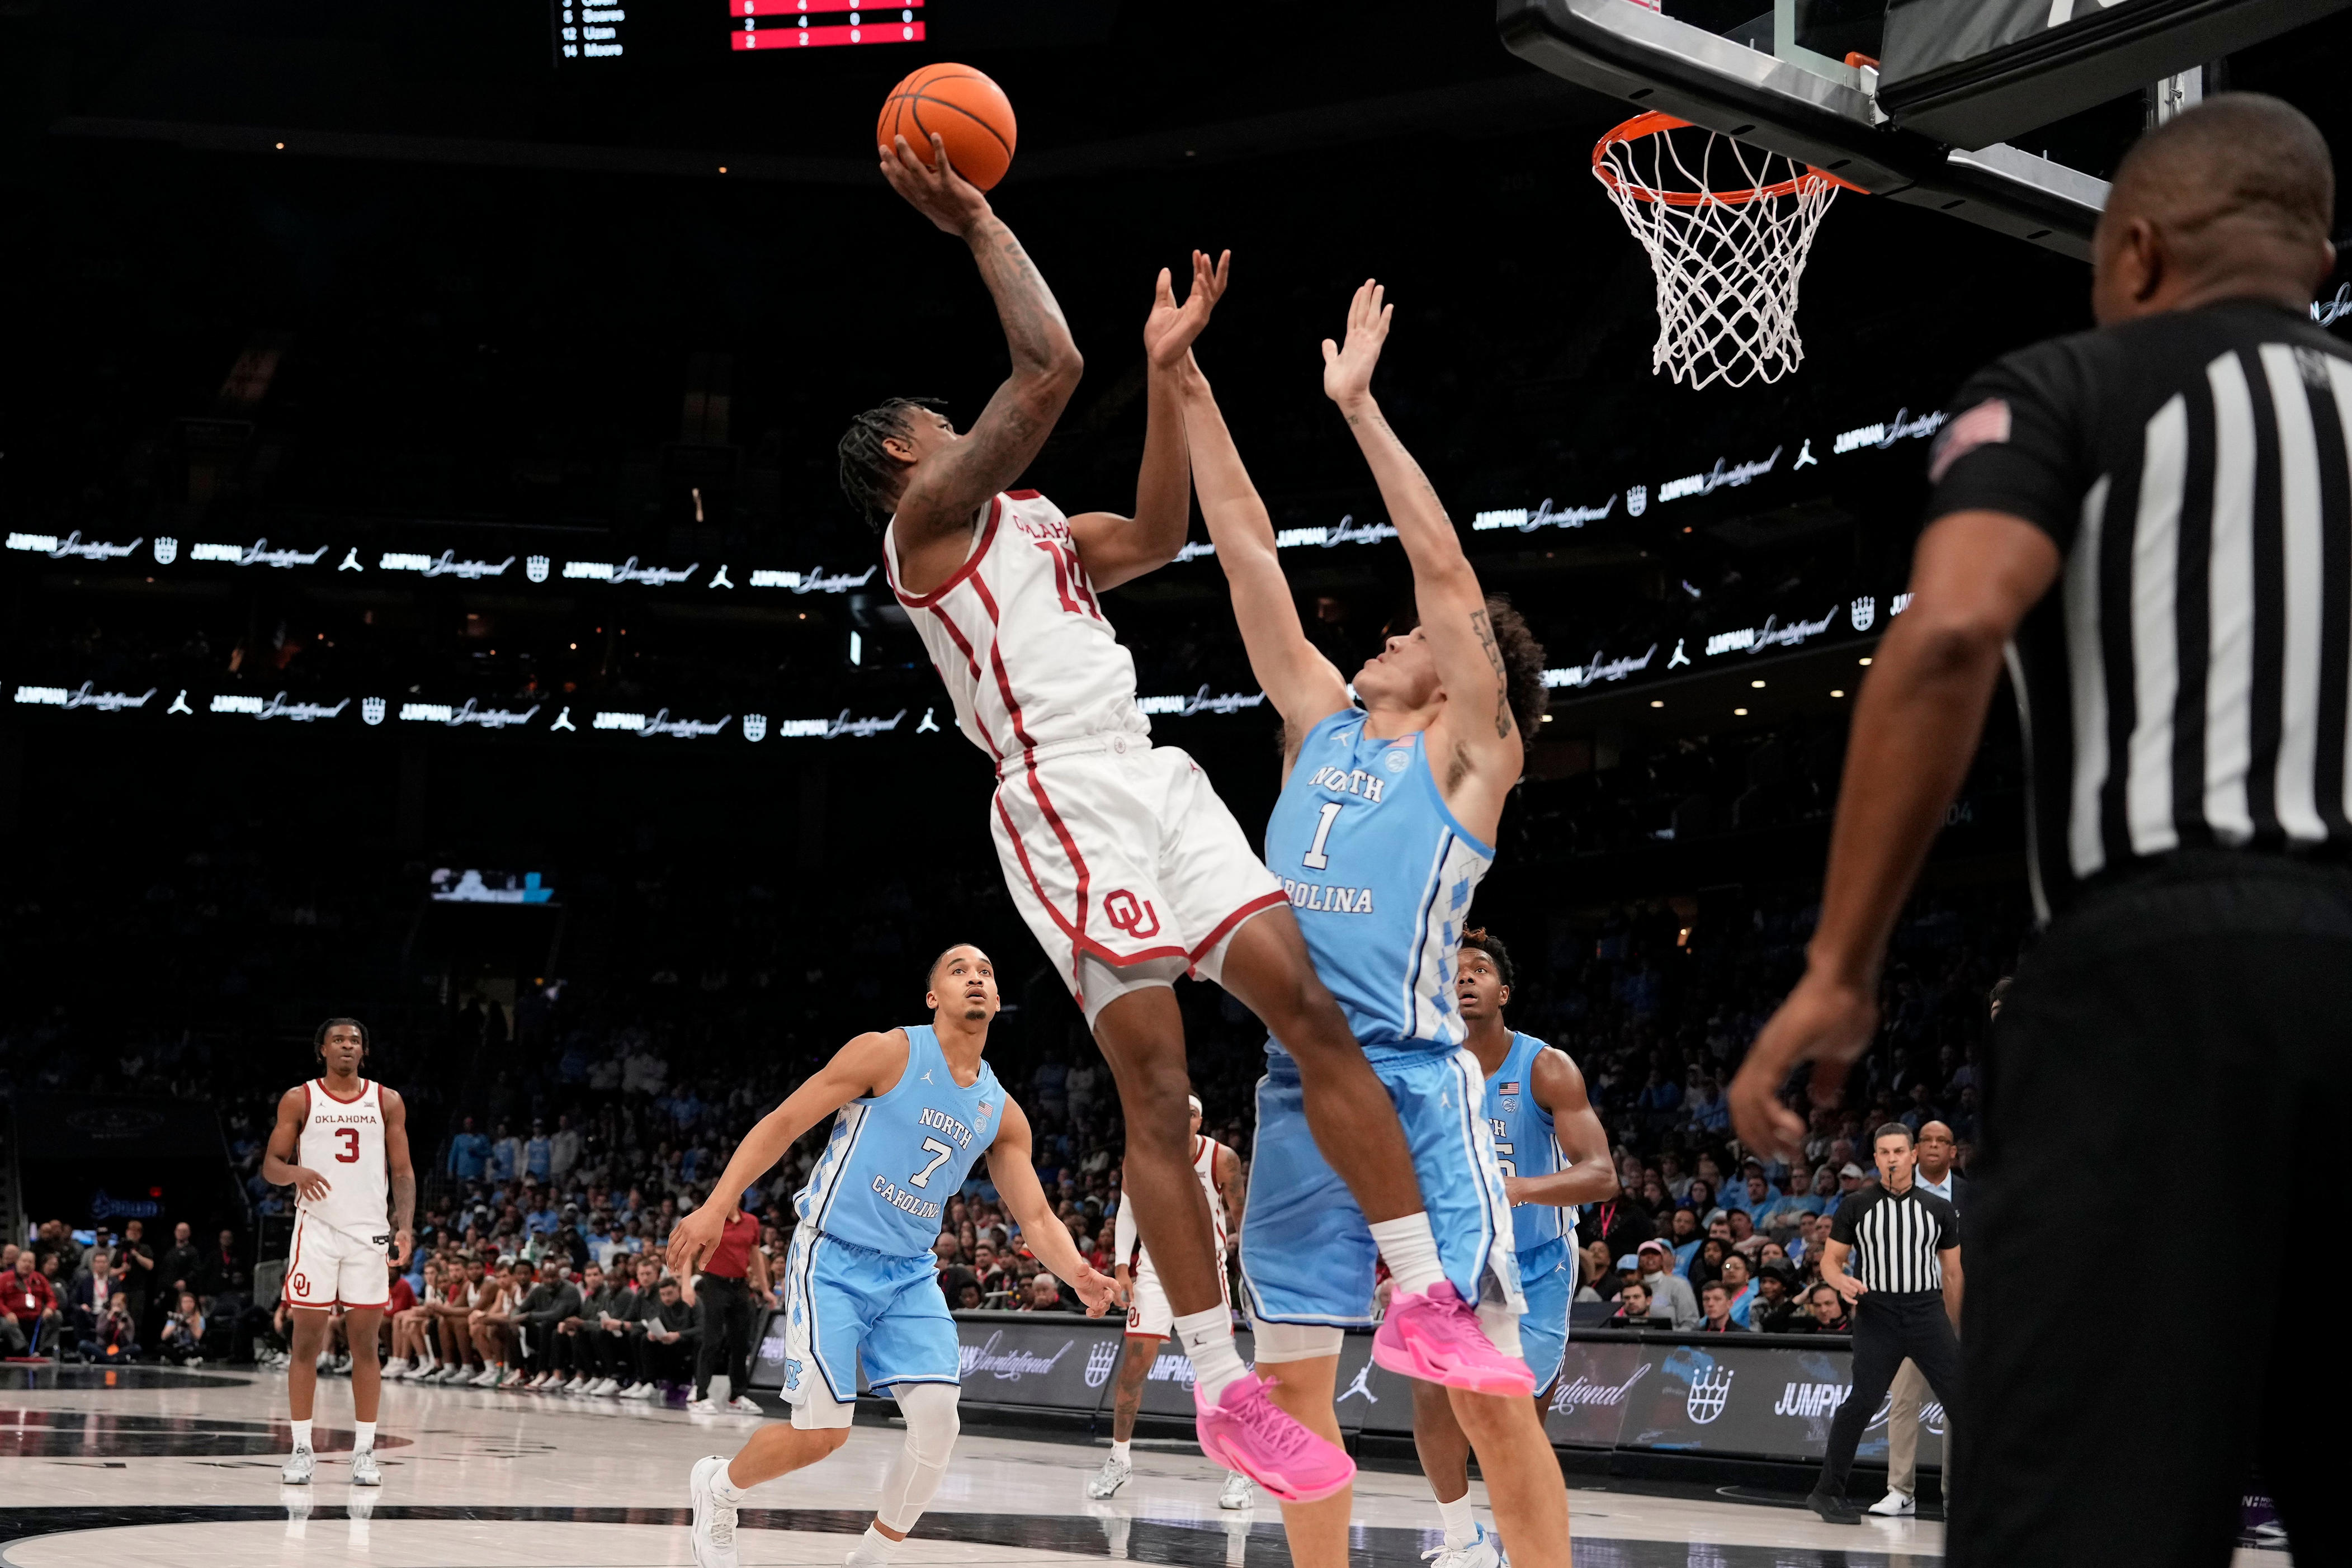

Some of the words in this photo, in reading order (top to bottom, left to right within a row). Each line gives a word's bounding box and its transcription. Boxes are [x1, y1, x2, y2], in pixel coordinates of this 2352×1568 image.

[849, 12, 860, 26] 0
[902, 9, 913, 23] 0
[851, 29, 861, 43] 0
[903, 26, 913, 40] 0
[1302, 801, 1343, 871] 1
[1103, 889, 1161, 939] OU
[315, 1115, 377, 1124] OKLAHOMA
[918, 1106, 973, 1151] NORTH
[335, 1127, 360, 1163] 3
[908, 1136, 953, 1189] 7
